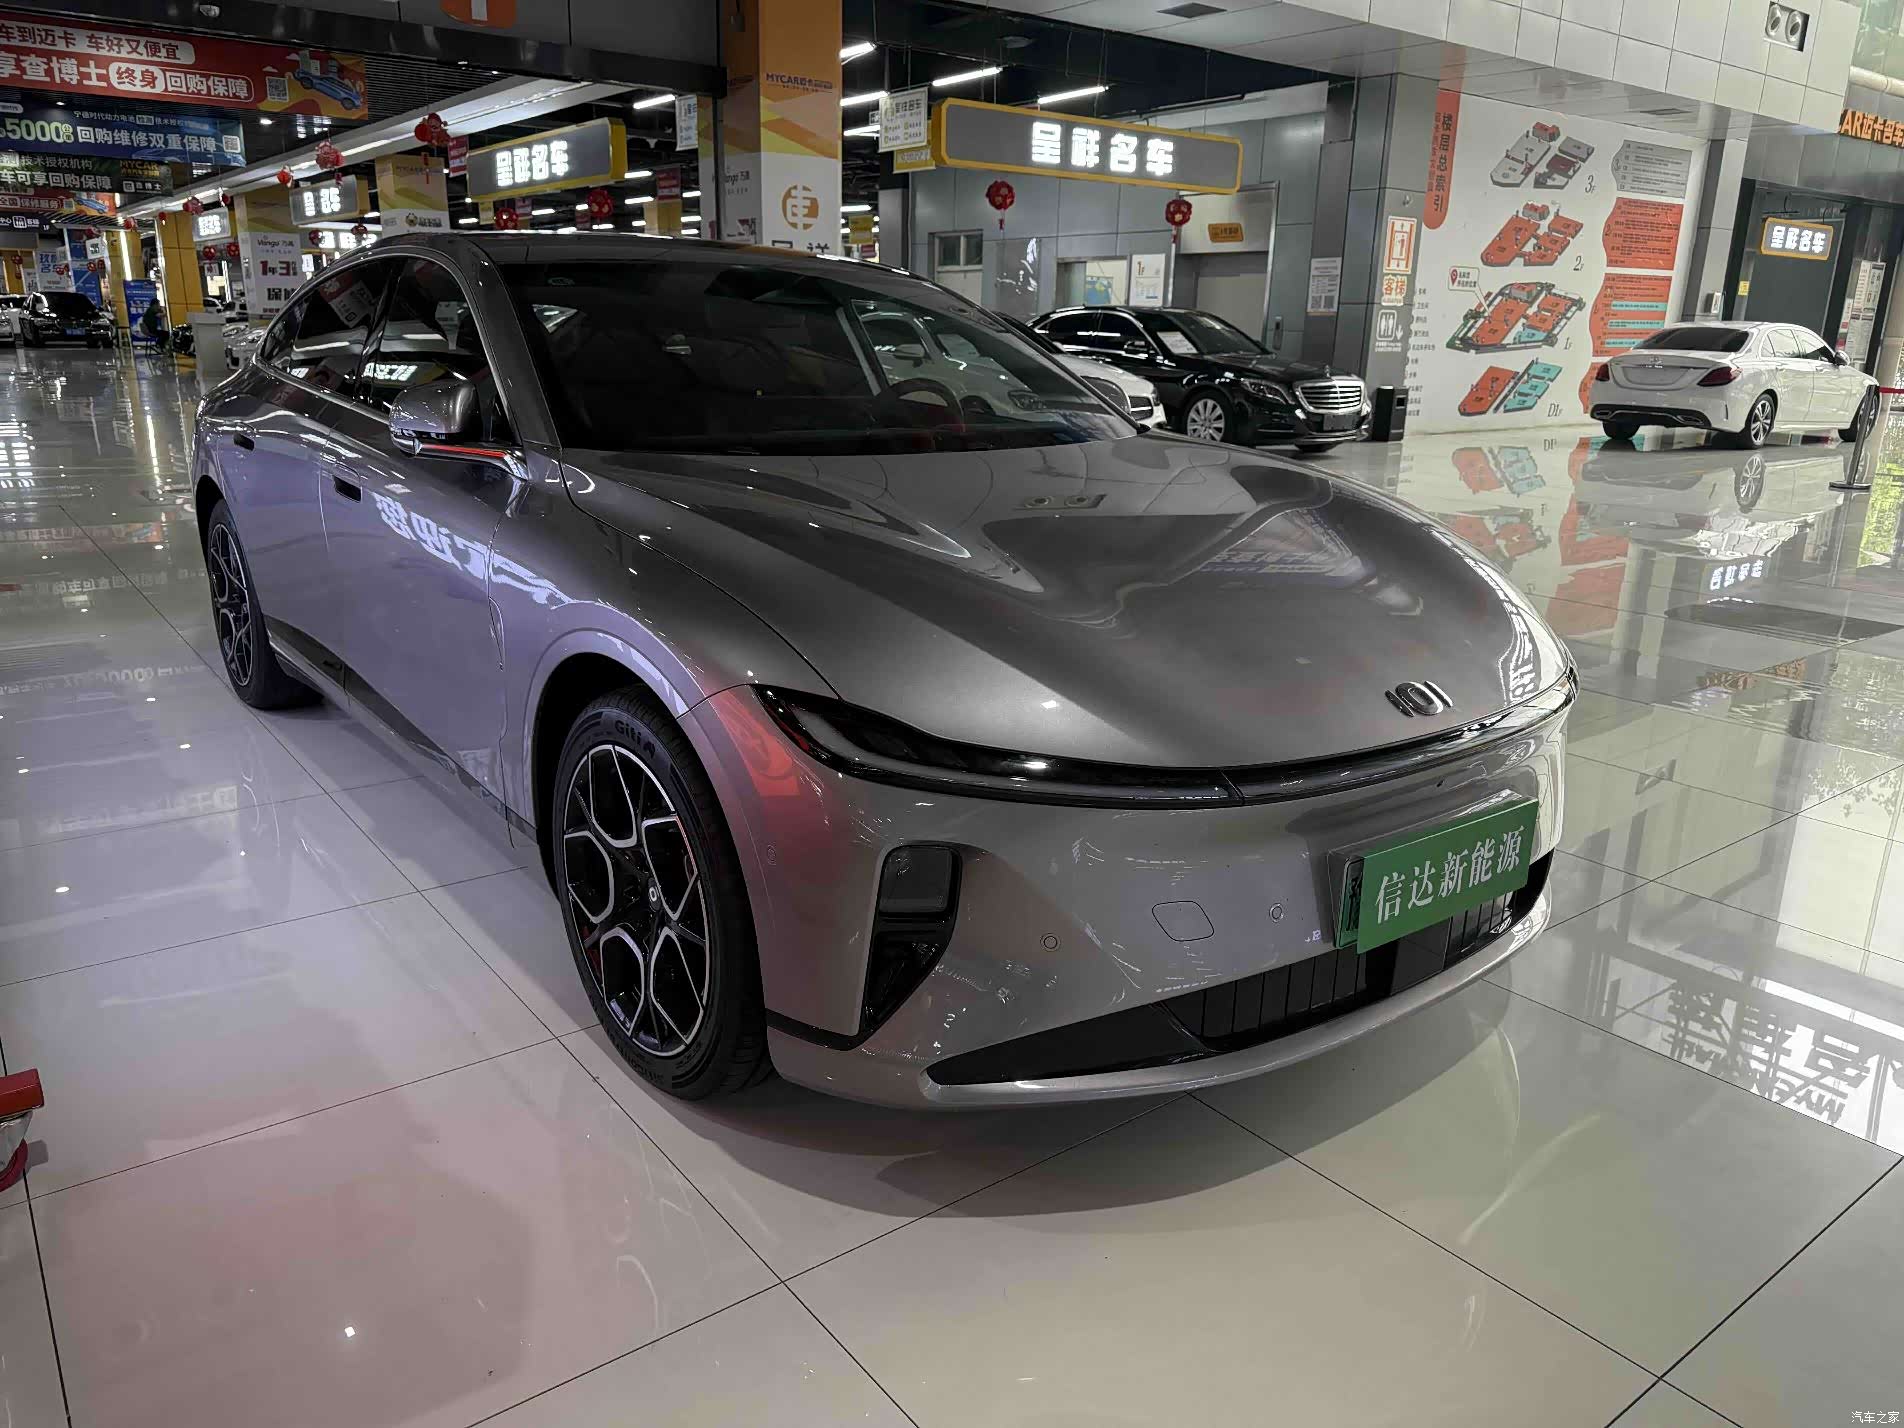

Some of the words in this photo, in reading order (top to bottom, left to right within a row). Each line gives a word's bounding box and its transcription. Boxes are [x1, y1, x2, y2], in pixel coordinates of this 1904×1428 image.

[86, 33, 181, 61] 车好又便宜
[614, 719, 642, 744] Giti
[1375, 825, 1525, 925] 信达新能源
